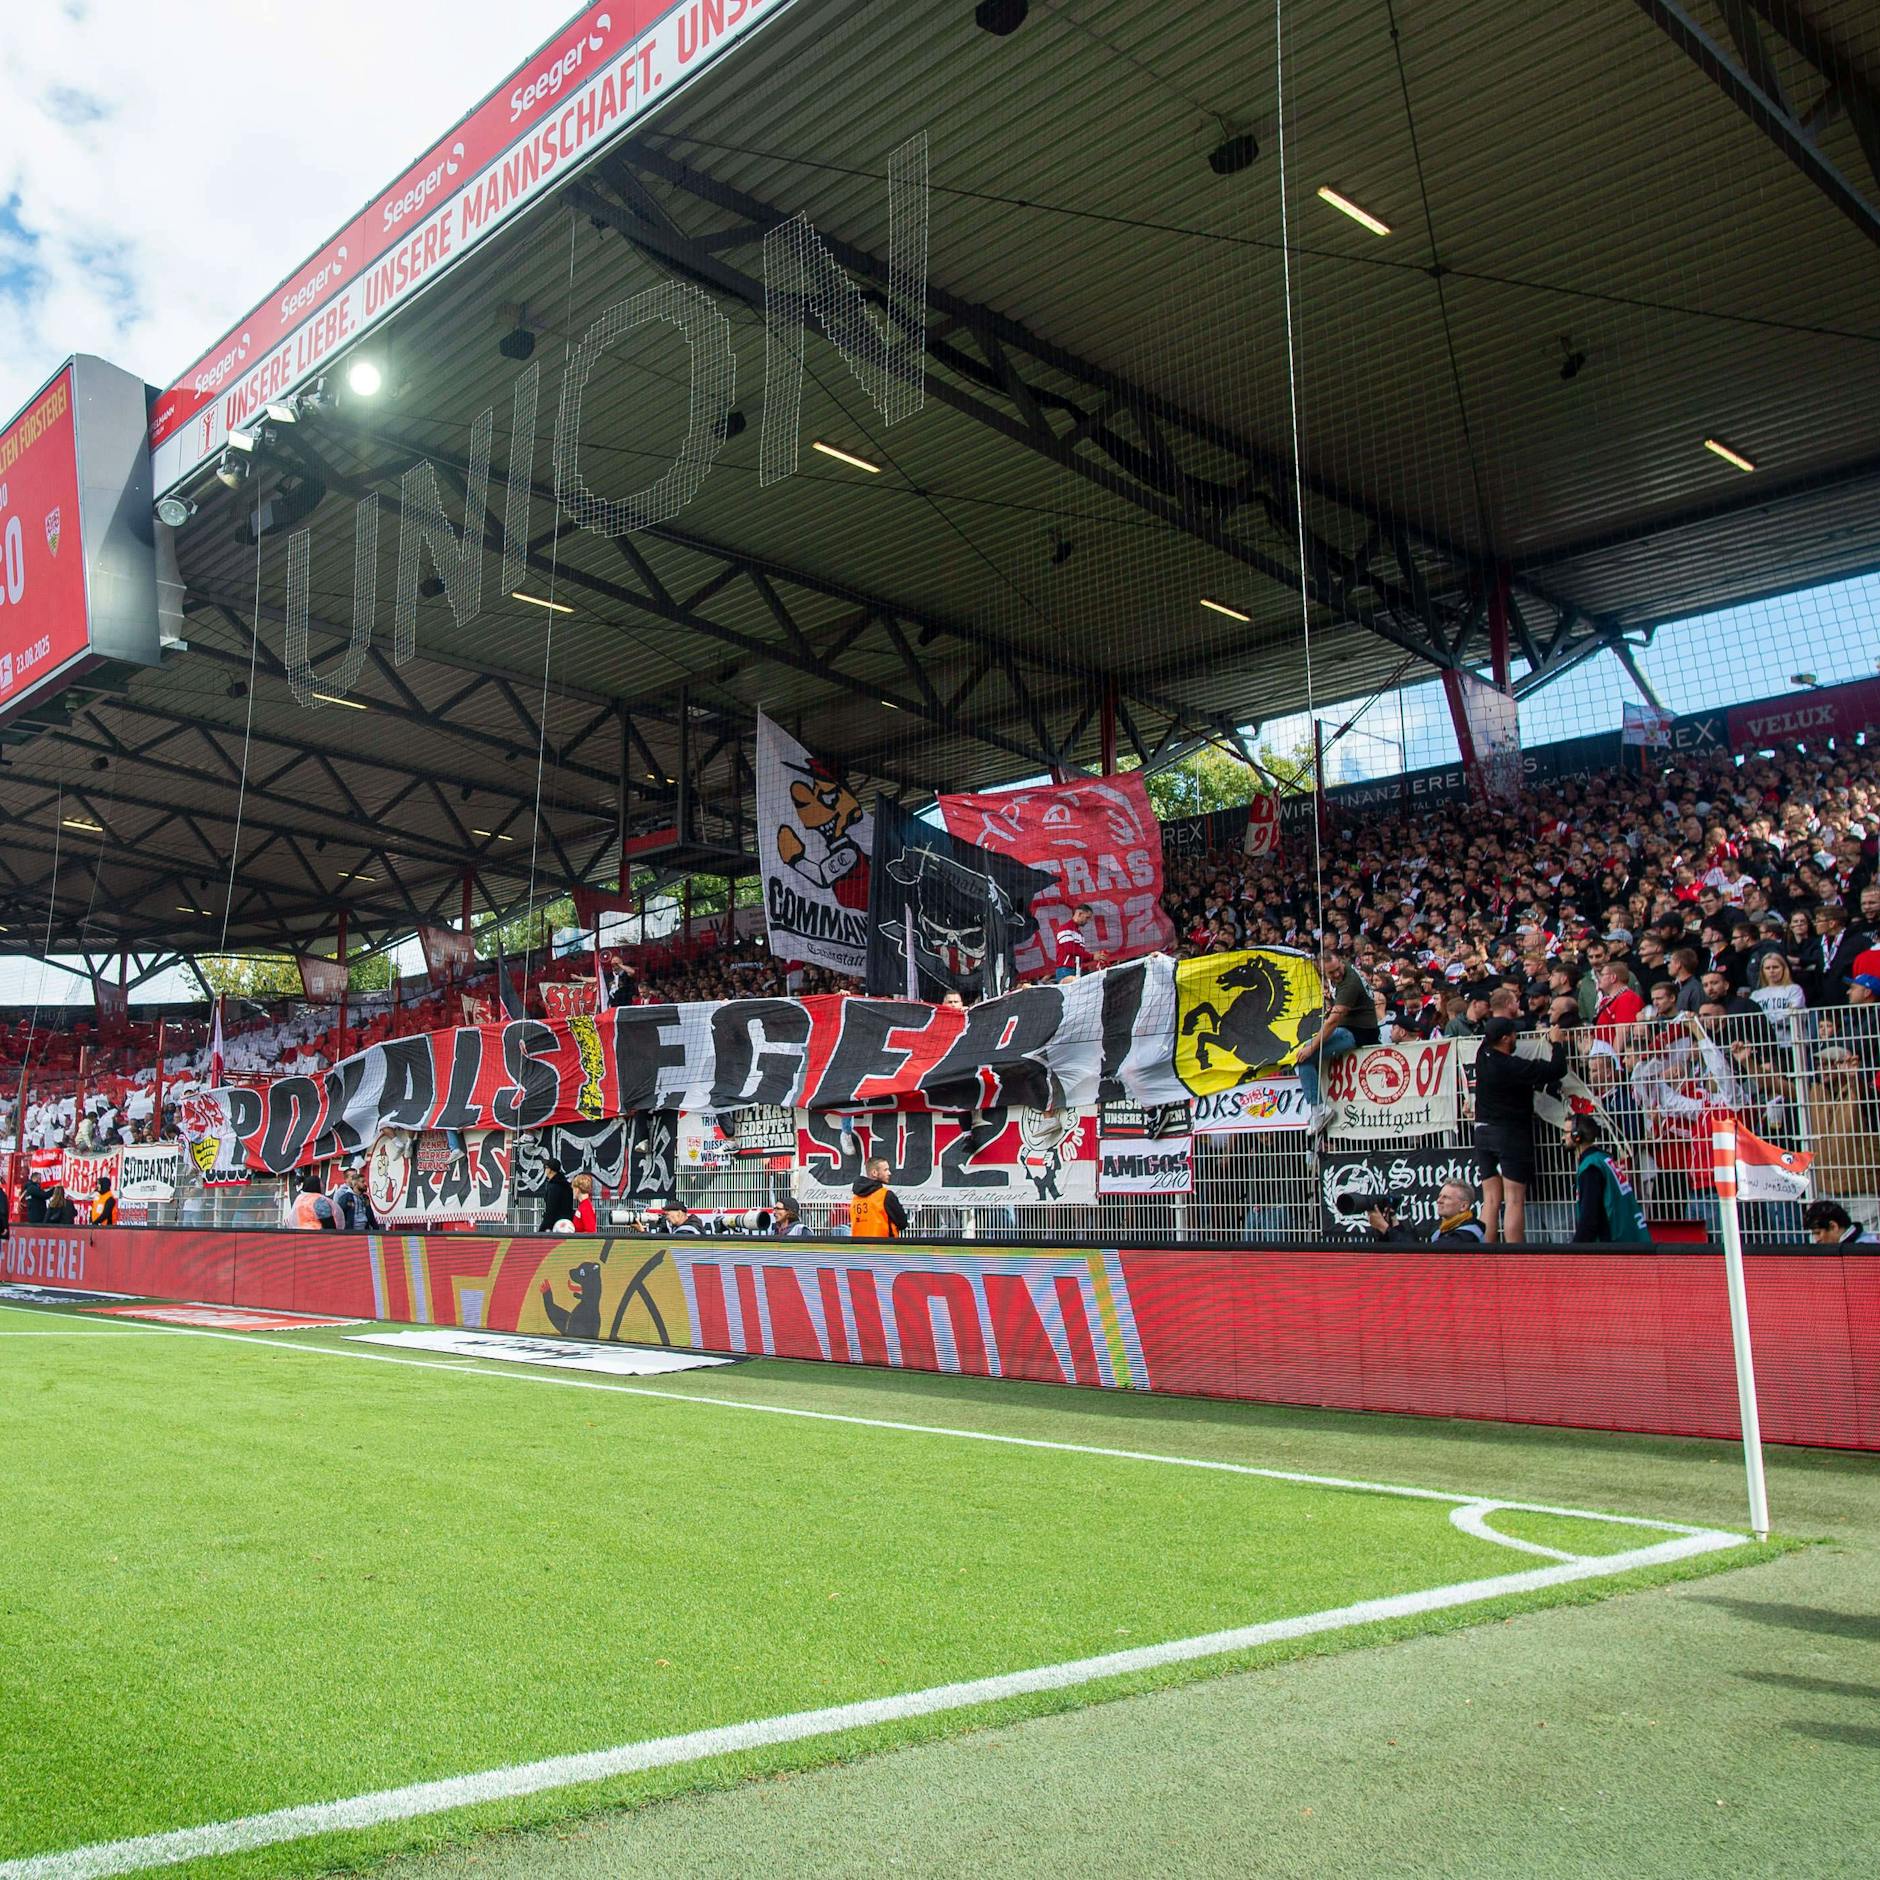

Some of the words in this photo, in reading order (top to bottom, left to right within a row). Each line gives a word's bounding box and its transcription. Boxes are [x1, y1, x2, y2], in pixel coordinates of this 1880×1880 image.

[509, 37, 587, 122] Seeger
[365, 210, 451, 316] UNSERE
[461, 39, 663, 240] MANNSCHAFT.
[677, 0, 765, 64] UNS
[383, 166, 446, 232] Seeger
[280, 265, 332, 325] Seeger
[194, 345, 239, 400] Seeger
[226, 345, 292, 431] UNSERE
[297, 295, 356, 374] LIEBE.
[19, 382, 67, 455] FÖRSTEREI
[285, 130, 928, 709] UNION
[16, 633, 50, 675] 23.08.2025
[1747, 704, 1835, 738] VELUX
[1416, 1042, 1451, 1098] 07
[1104, 1113, 1142, 1125] UNSERE
[1341, 1102, 1432, 1133] Stuttgart
[123, 1155, 177, 1188] SÜDBANDE
[1150, 1172, 1190, 1190] 2010
